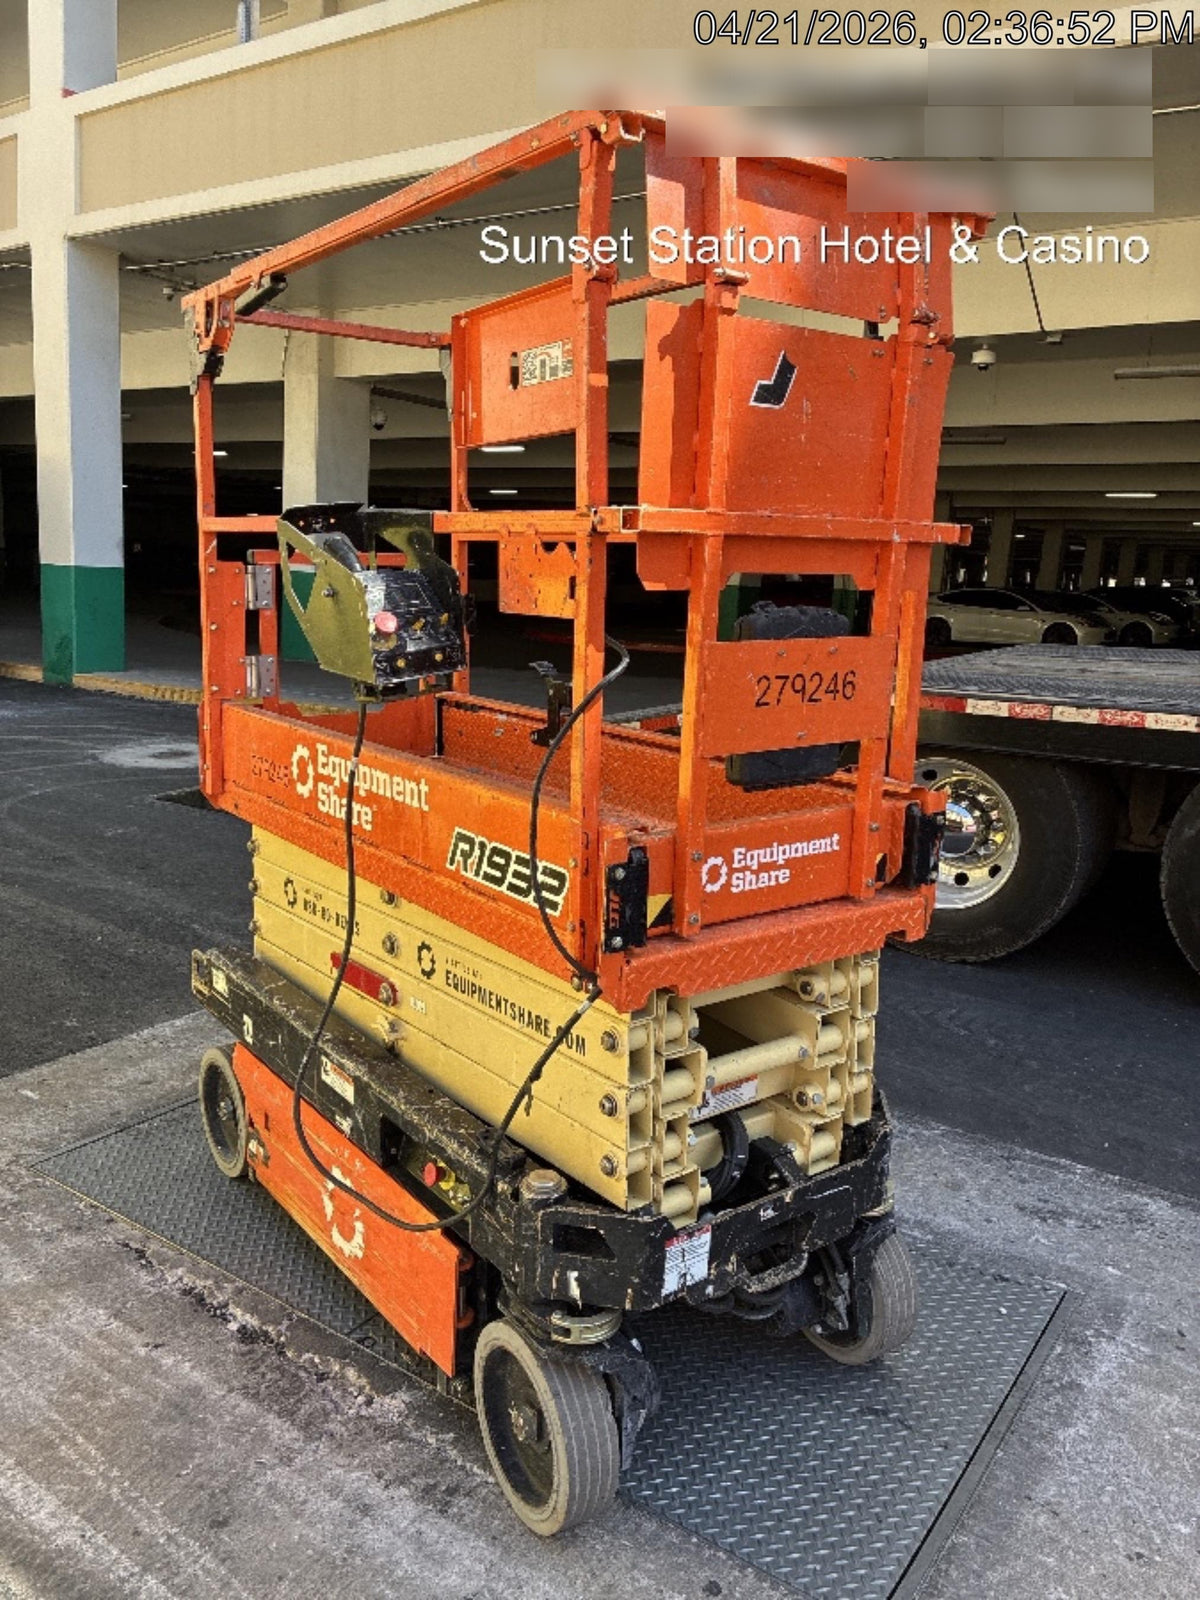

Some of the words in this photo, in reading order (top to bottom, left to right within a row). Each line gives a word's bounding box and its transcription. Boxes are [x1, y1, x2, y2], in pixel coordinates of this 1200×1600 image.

[755, 670, 856, 708] 279246
[732, 833, 841, 870] Equipment
[730, 867, 791, 893] Share
